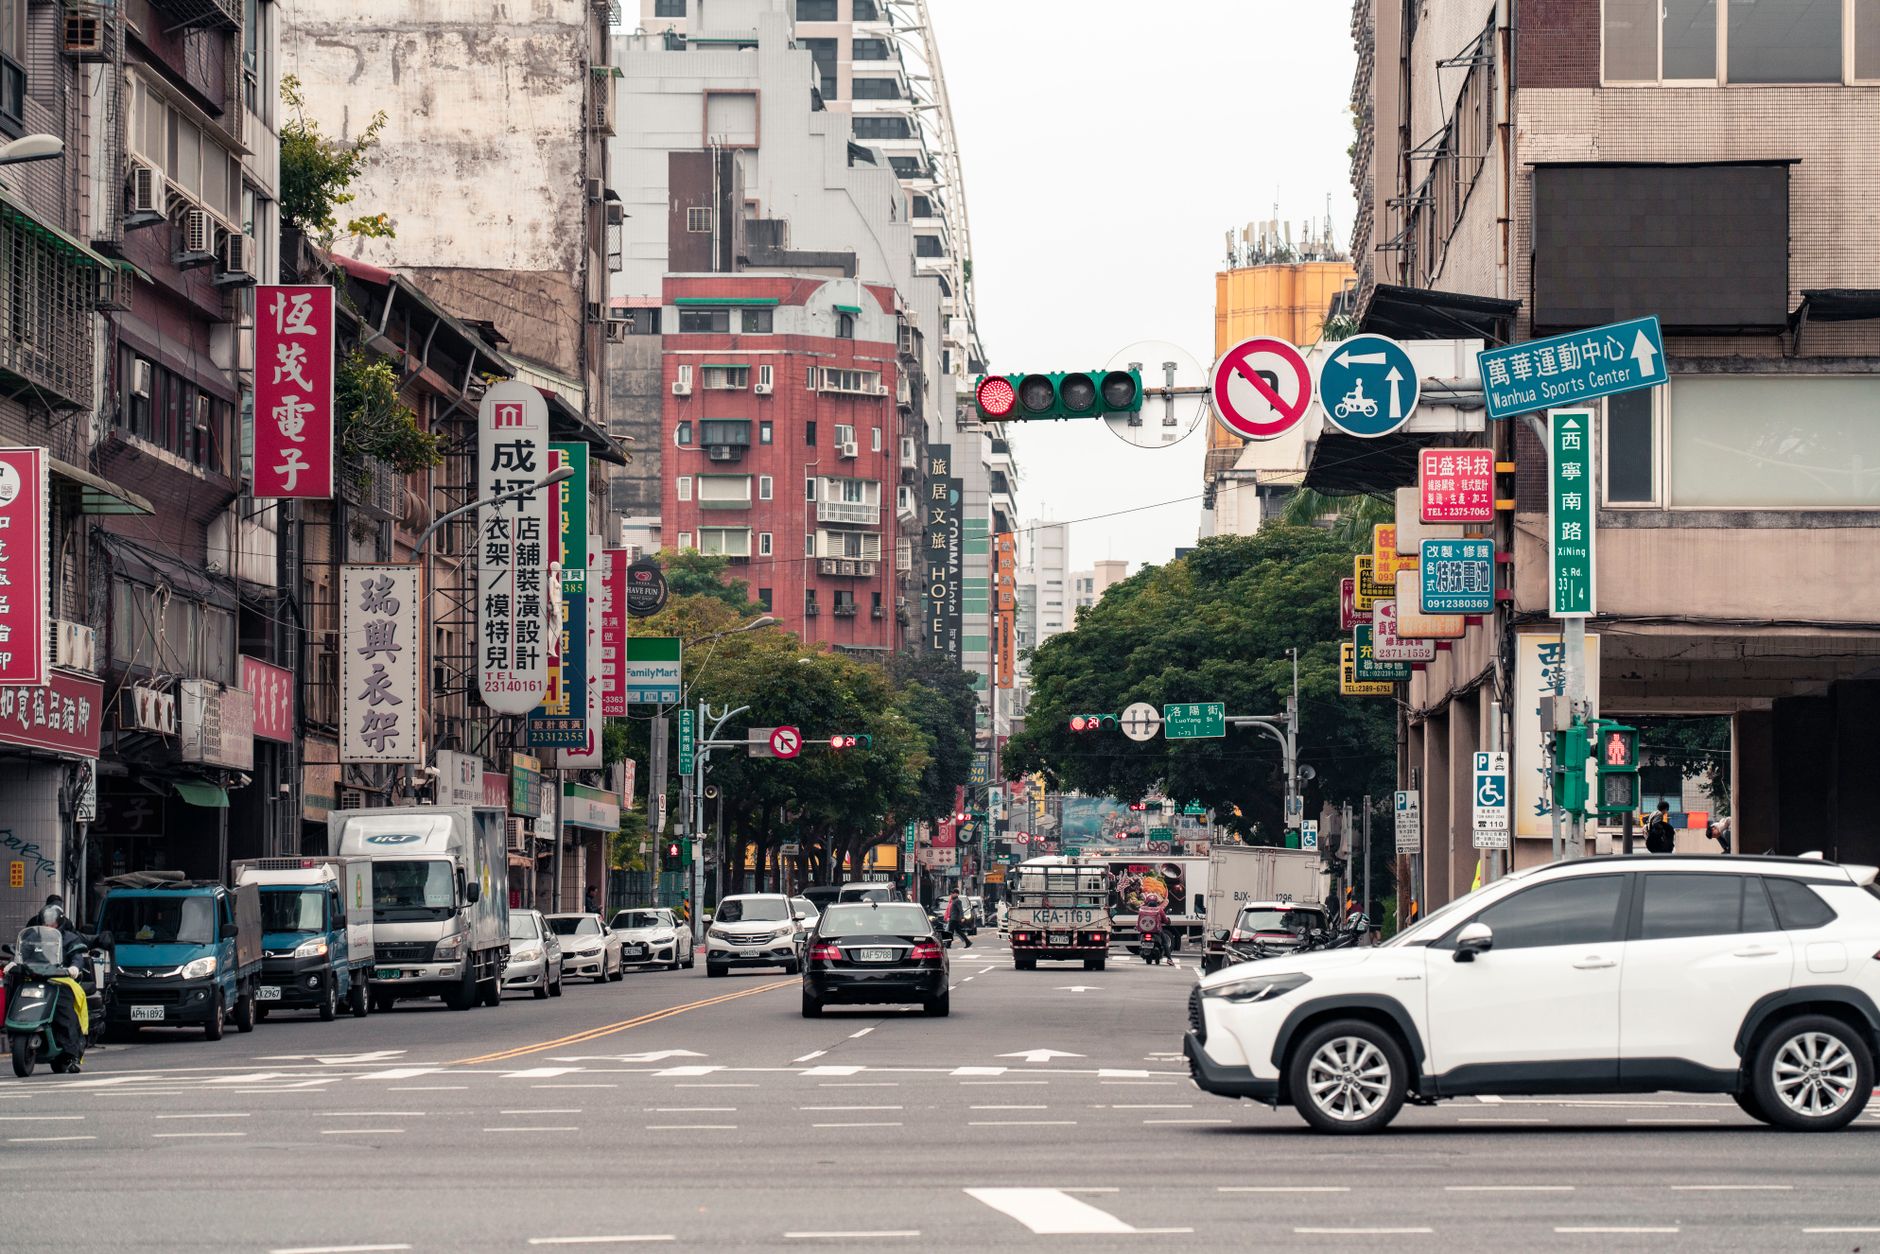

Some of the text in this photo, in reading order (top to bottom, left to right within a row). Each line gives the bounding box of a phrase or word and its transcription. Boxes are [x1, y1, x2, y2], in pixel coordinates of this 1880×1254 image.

[1485, 334, 1626, 389] 萬華運動中心
[269, 291, 318, 492] 恆茂電子
[1491, 367, 1631, 409] Wanhua Sports Center
[1426, 455, 1489, 476] 日盛科技
[490, 439, 537, 512] 成坪
[1561, 431, 1582, 541] 西寧南路
[931, 458, 947, 549] 旅居文旅
[1557, 547, 1586, 558] XiNing
[949, 517, 958, 616] COMMA Hotel
[1562, 567, 1583, 576] S. Rd.
[1427, 562, 1435, 591] 各式
[1578, 587, 1584, 600] 4
[930, 567, 947, 649] HOTEL
[1427, 599, 1489, 608] 0912380369
[1379, 649, 1431, 657] 2371-1552
[357, 573, 403, 752] 瑞興衣架
[485, 672, 518, 680] TEL
[627, 668, 678, 679] FamilyMart
[484, 680, 543, 693] 23140161
[1171, 704, 1219, 717] 洛陽街
[1088, 718, 1099, 729] 24
[532, 732, 583, 741] 23312355
[846, 737, 856, 747] 24
[373, 834, 411, 843] HCT
[1033, 910, 1092, 923] KEA-1169
